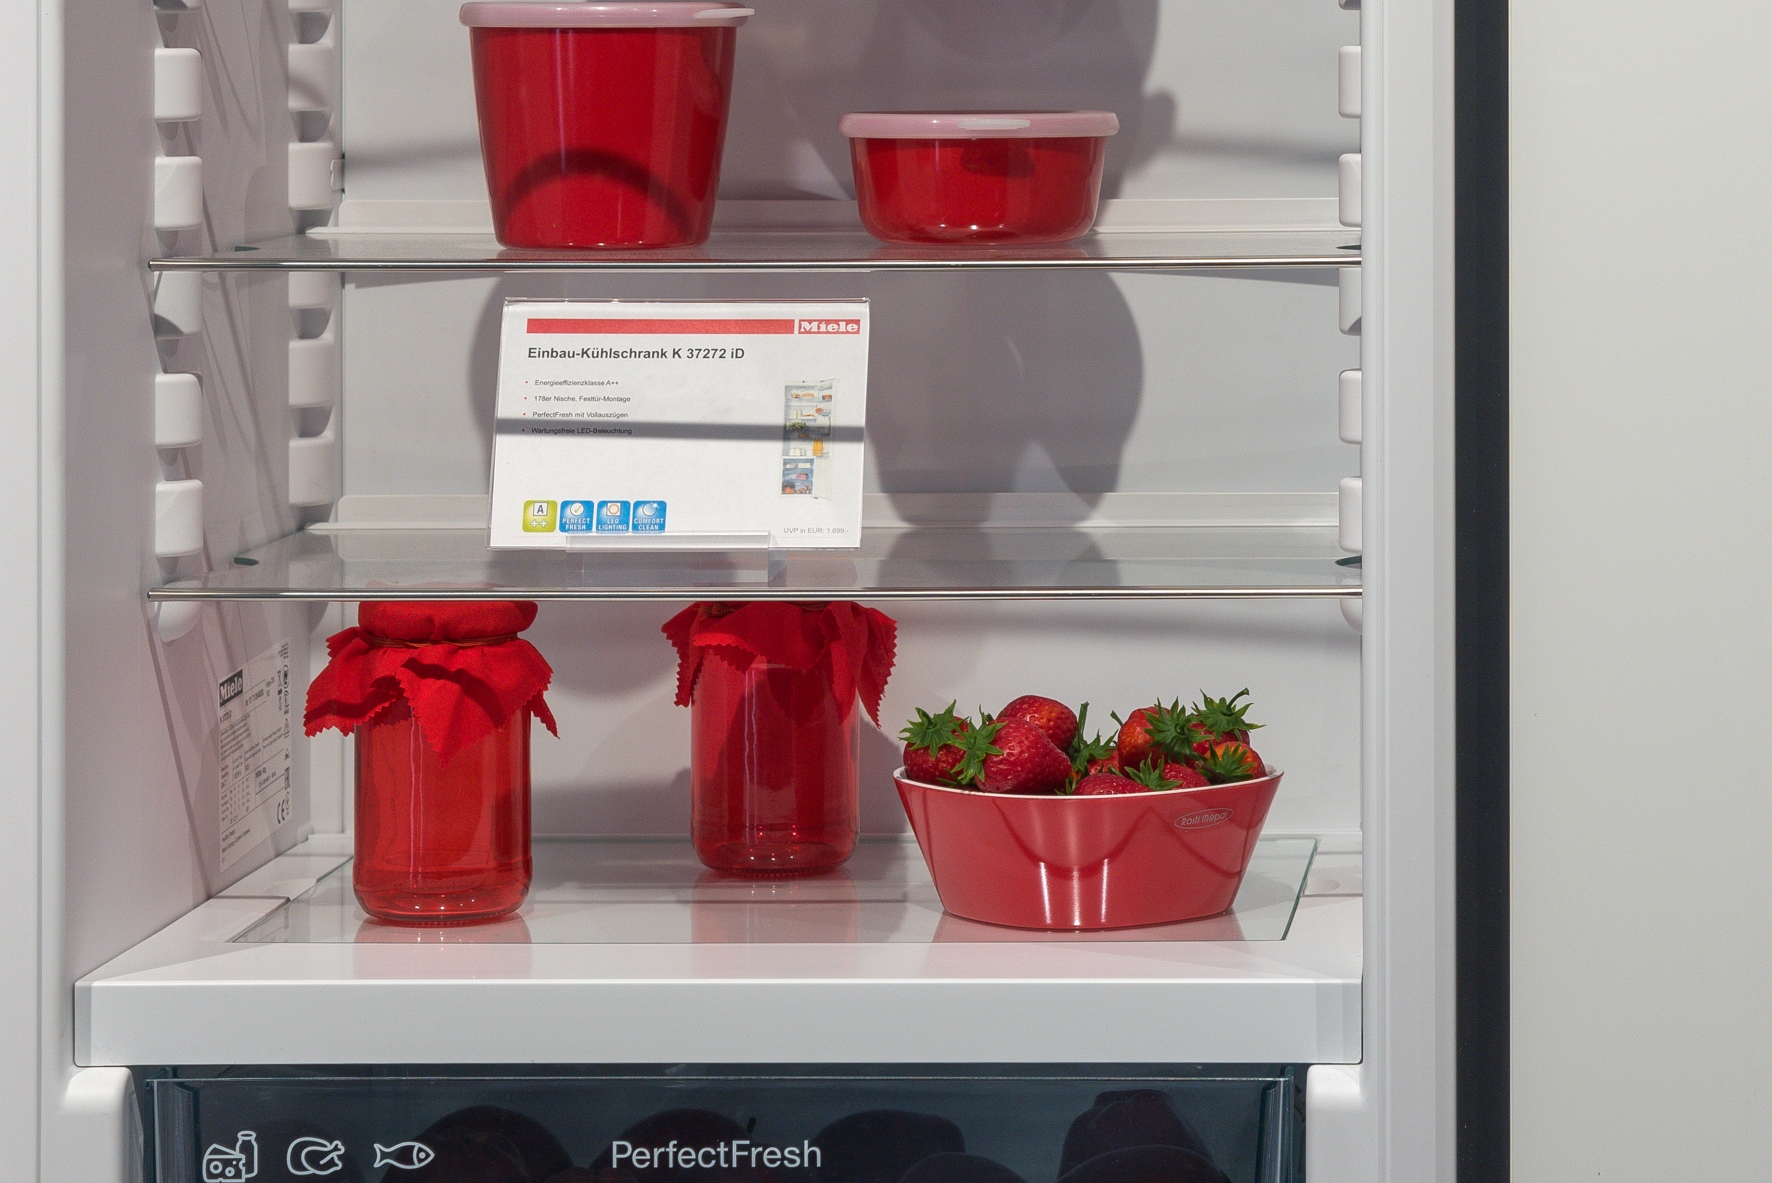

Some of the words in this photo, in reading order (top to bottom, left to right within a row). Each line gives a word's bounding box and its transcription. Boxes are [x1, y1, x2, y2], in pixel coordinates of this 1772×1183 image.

[800, 321, 859, 333] Miele
[527, 347, 668, 359] Einbau-Kühlschrank
[672, 348, 682, 359] K
[686, 348, 727, 359] 37272
[731, 348, 745, 359] iD
[534, 379, 605, 387] Energieeffizienzklasse
[578, 396, 631, 404] Festtür-Montage
[586, 411, 629, 420] Vollauszügen
[531, 427, 576, 435] Wartungsfreie
[576, 427, 633, 436] LED-Beleuchtung
[633, 517, 664, 525] COMFORT
[219, 675, 243, 703] Miele
[1180, 815, 1201, 826] Rosti
[1201, 810, 1229, 823] Mepal
[612, 1139, 822, 1169] PerfectFresh
